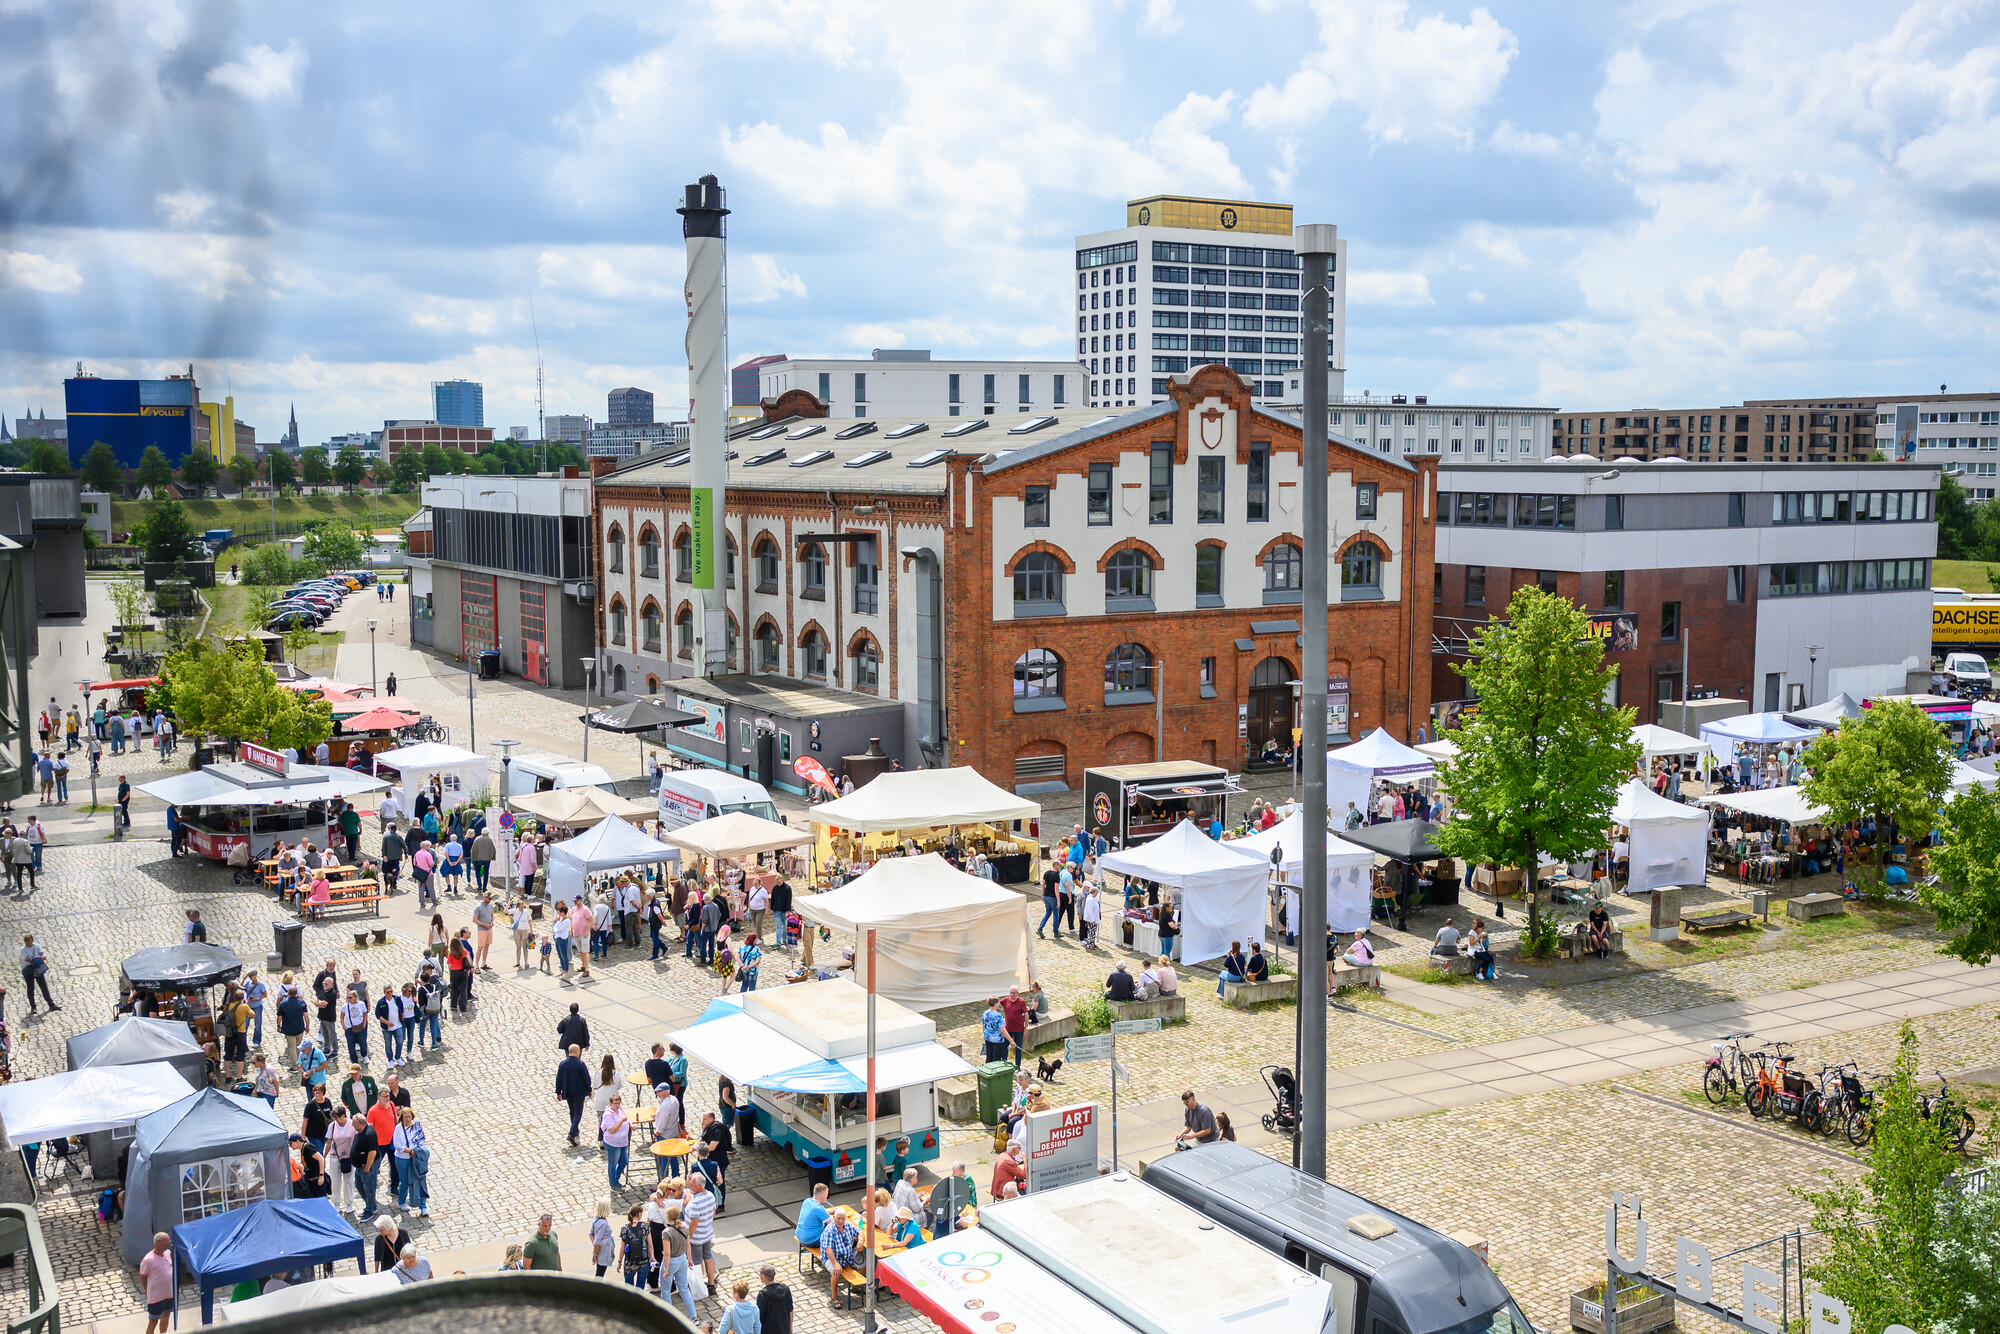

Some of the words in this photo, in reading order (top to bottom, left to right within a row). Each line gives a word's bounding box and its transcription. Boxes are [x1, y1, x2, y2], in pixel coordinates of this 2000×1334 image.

[153, 409, 185, 417] VOLLERS
[694, 520, 701, 529] IT
[695, 560, 702, 574] We
[1933, 610, 2000, 625] DACHSE
[1934, 627, 1971, 635] ntelligent
[1973, 627, 2000, 635] Logisti
[252, 749, 278, 768] HAAKE-BECK
[1064, 1110, 1090, 1127] ART
[1052, 1126, 1082, 1141] MUSIC
[1041, 1139, 1067, 1151] DESIGN
[1033, 1149, 1054, 1158] THEORY
[1040, 1167, 1067, 1178] Hochschule
[1076, 1162, 1092, 1170] Künste
[1606, 1189, 1917, 1334] ÜBER
